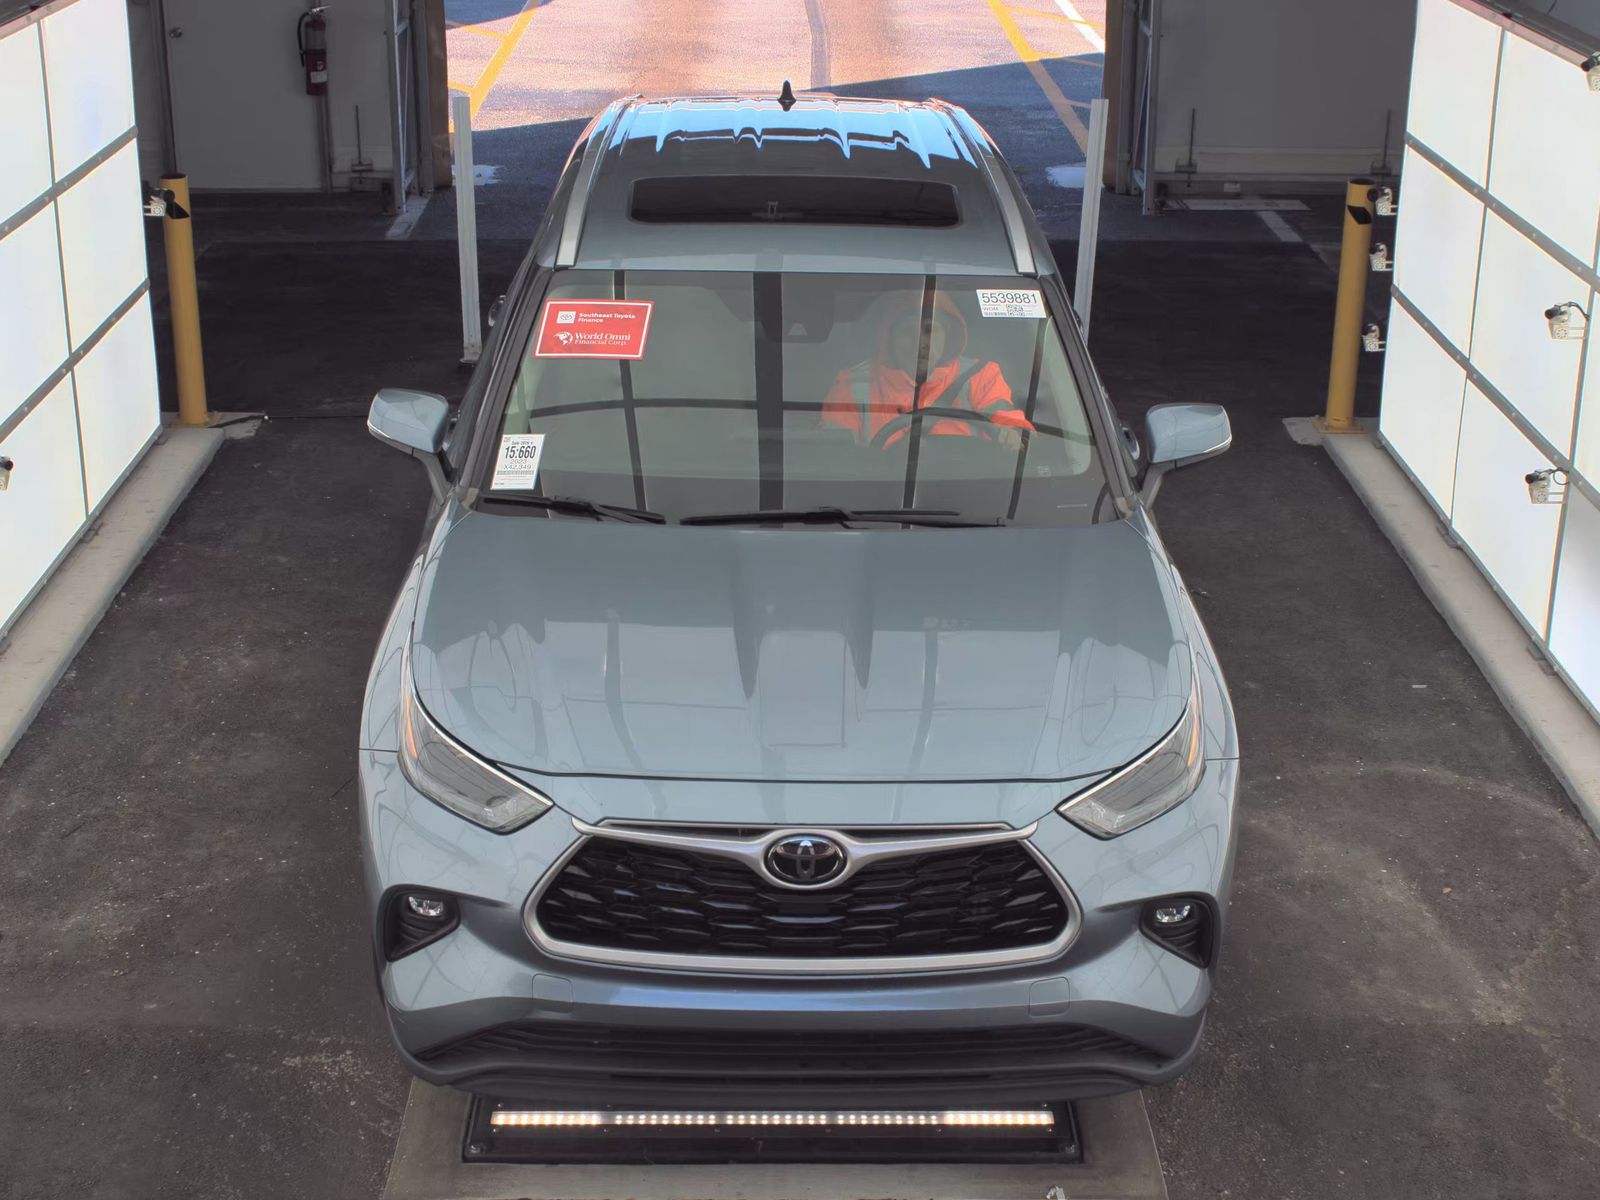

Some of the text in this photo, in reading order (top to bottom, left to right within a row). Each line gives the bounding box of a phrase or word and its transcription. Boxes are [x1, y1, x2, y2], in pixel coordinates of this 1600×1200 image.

[981, 292, 1037, 304] 5539881
[574, 332, 631, 341] World Omni
[505, 445, 537, 459] 15:660
